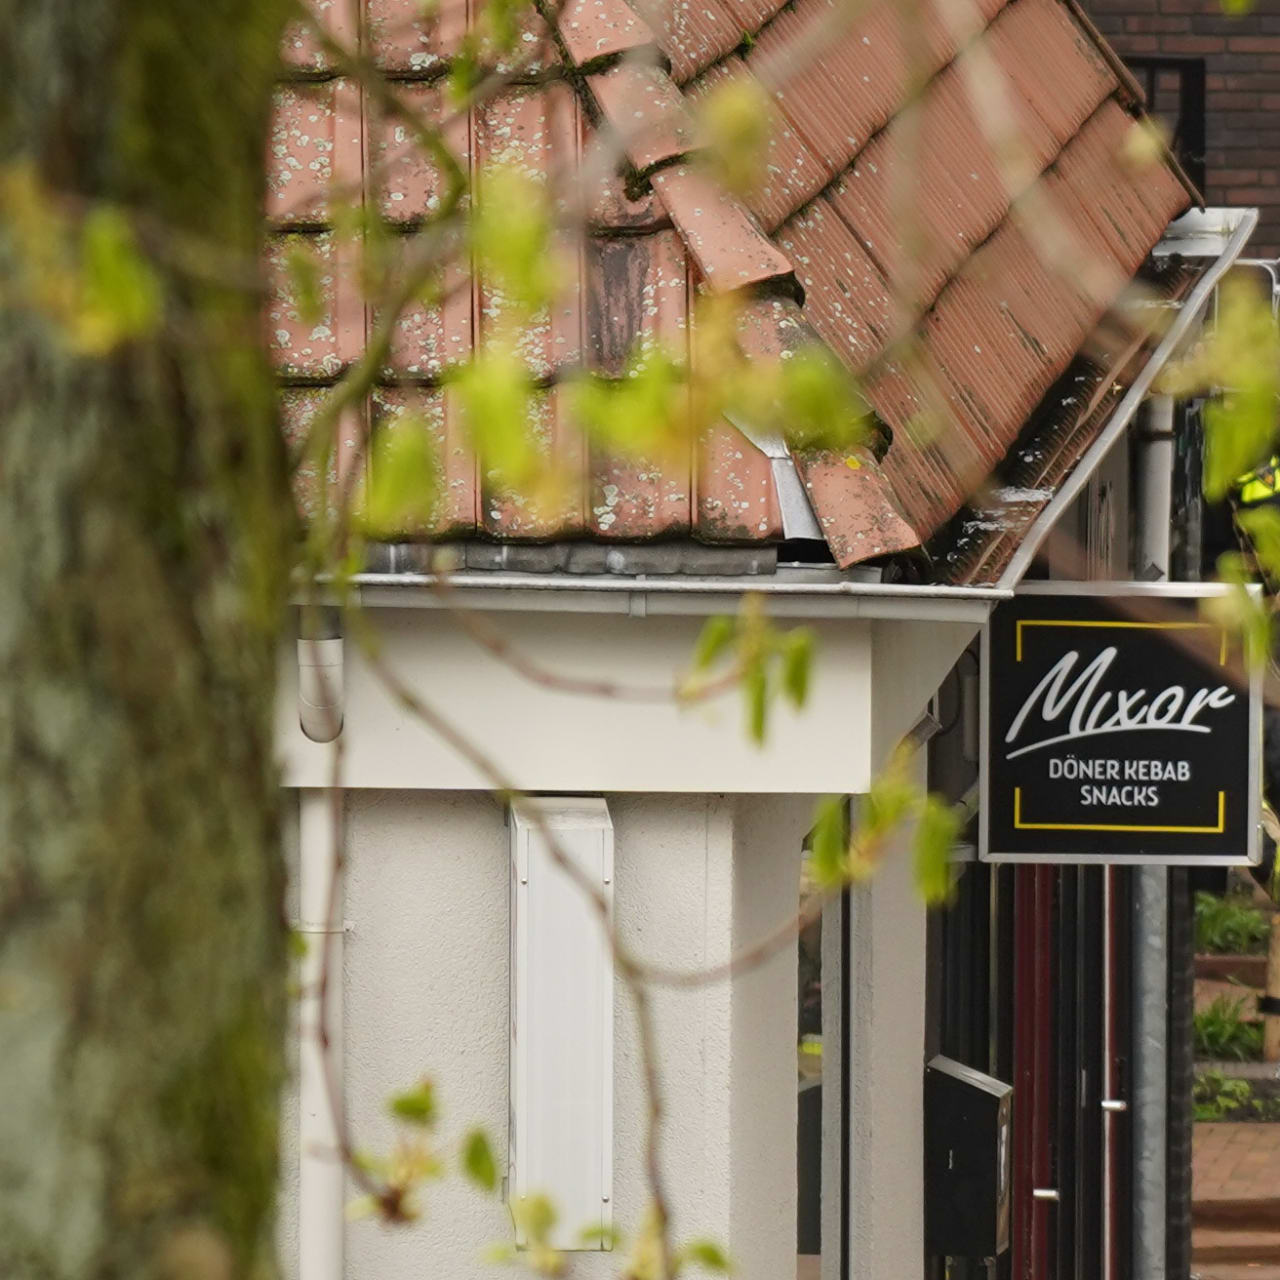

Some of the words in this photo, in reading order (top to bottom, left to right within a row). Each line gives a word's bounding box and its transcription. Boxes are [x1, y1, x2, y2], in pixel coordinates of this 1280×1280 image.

[1004, 646, 1236, 744] Mixor
[1049, 755, 1118, 780] DÖNER
[1125, 760, 1190, 781] KEBAB
[1080, 786, 1159, 806] SNACKS
